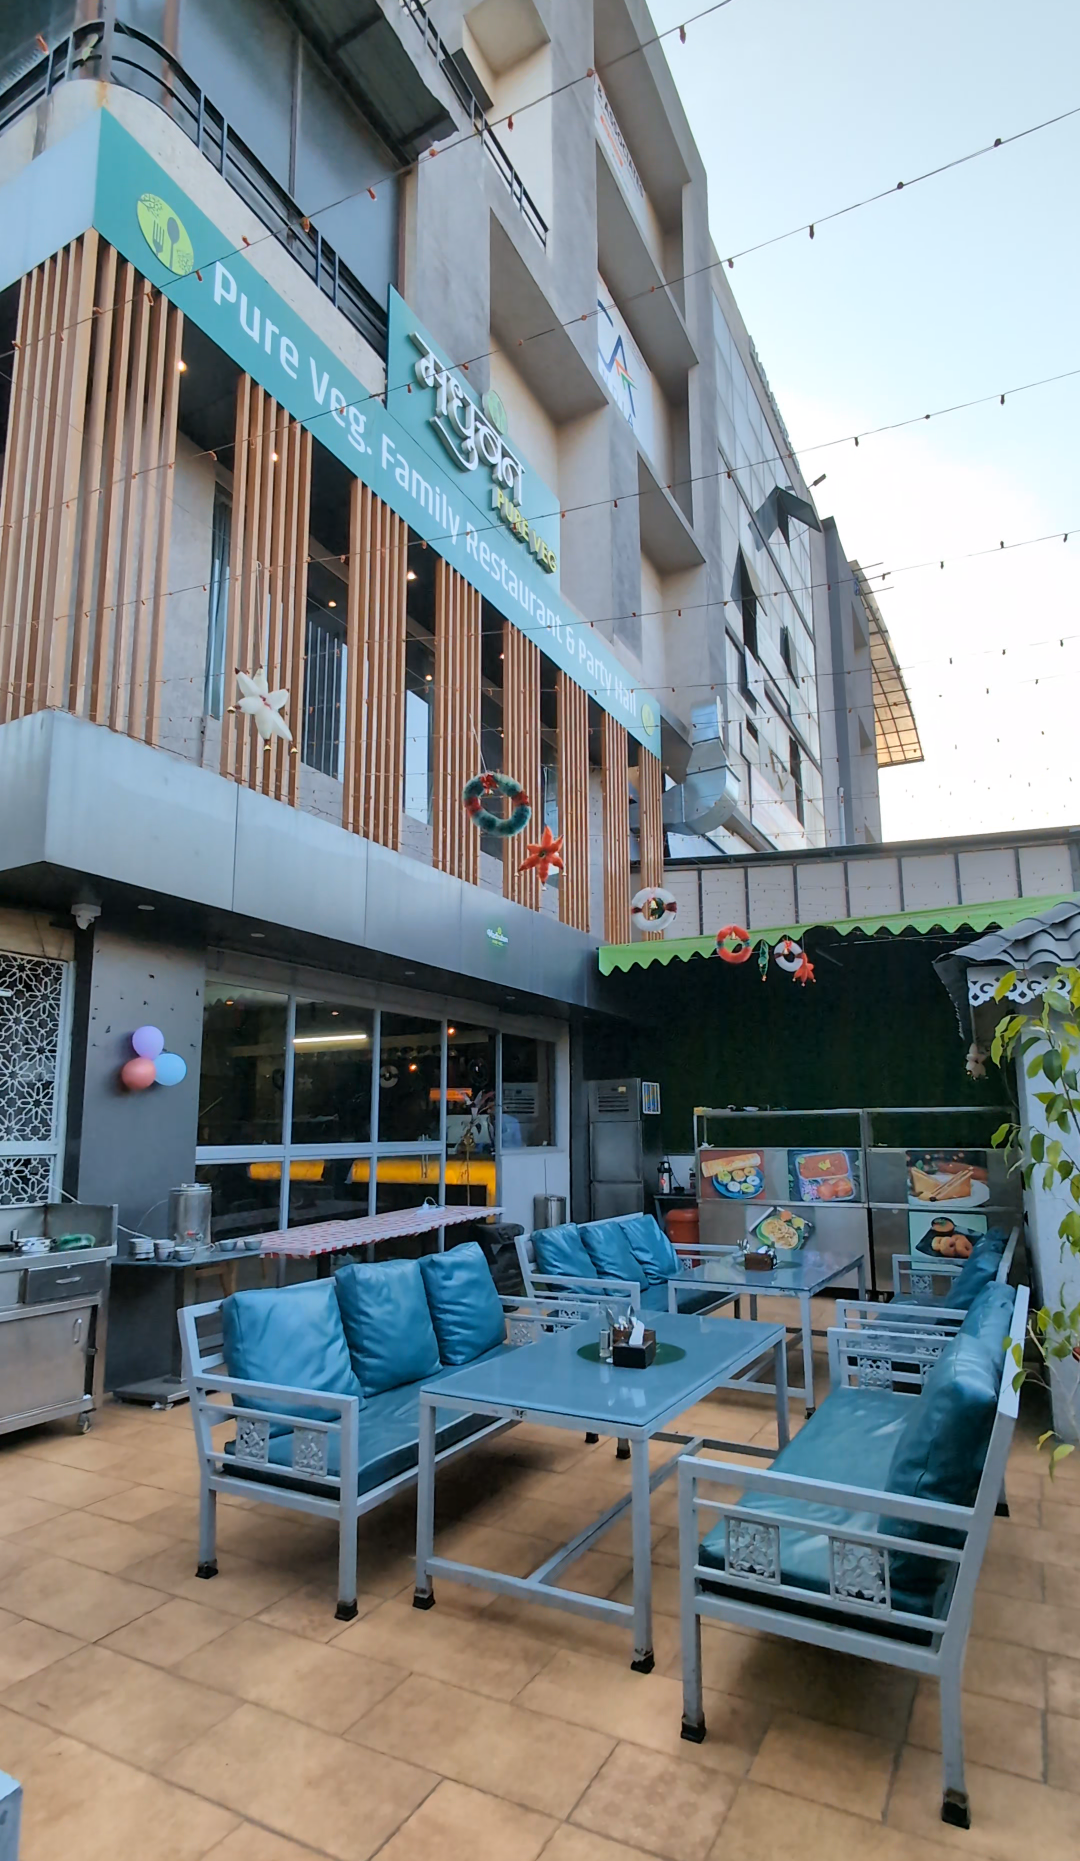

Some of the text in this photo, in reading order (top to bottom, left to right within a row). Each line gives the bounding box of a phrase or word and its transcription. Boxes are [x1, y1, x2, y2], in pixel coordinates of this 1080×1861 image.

[213, 260, 636, 718] Pure Veg. Family Restaurant & Party Hall
[408, 331, 526, 507] मधुबन
[493, 486, 557, 574] PURE VEG
